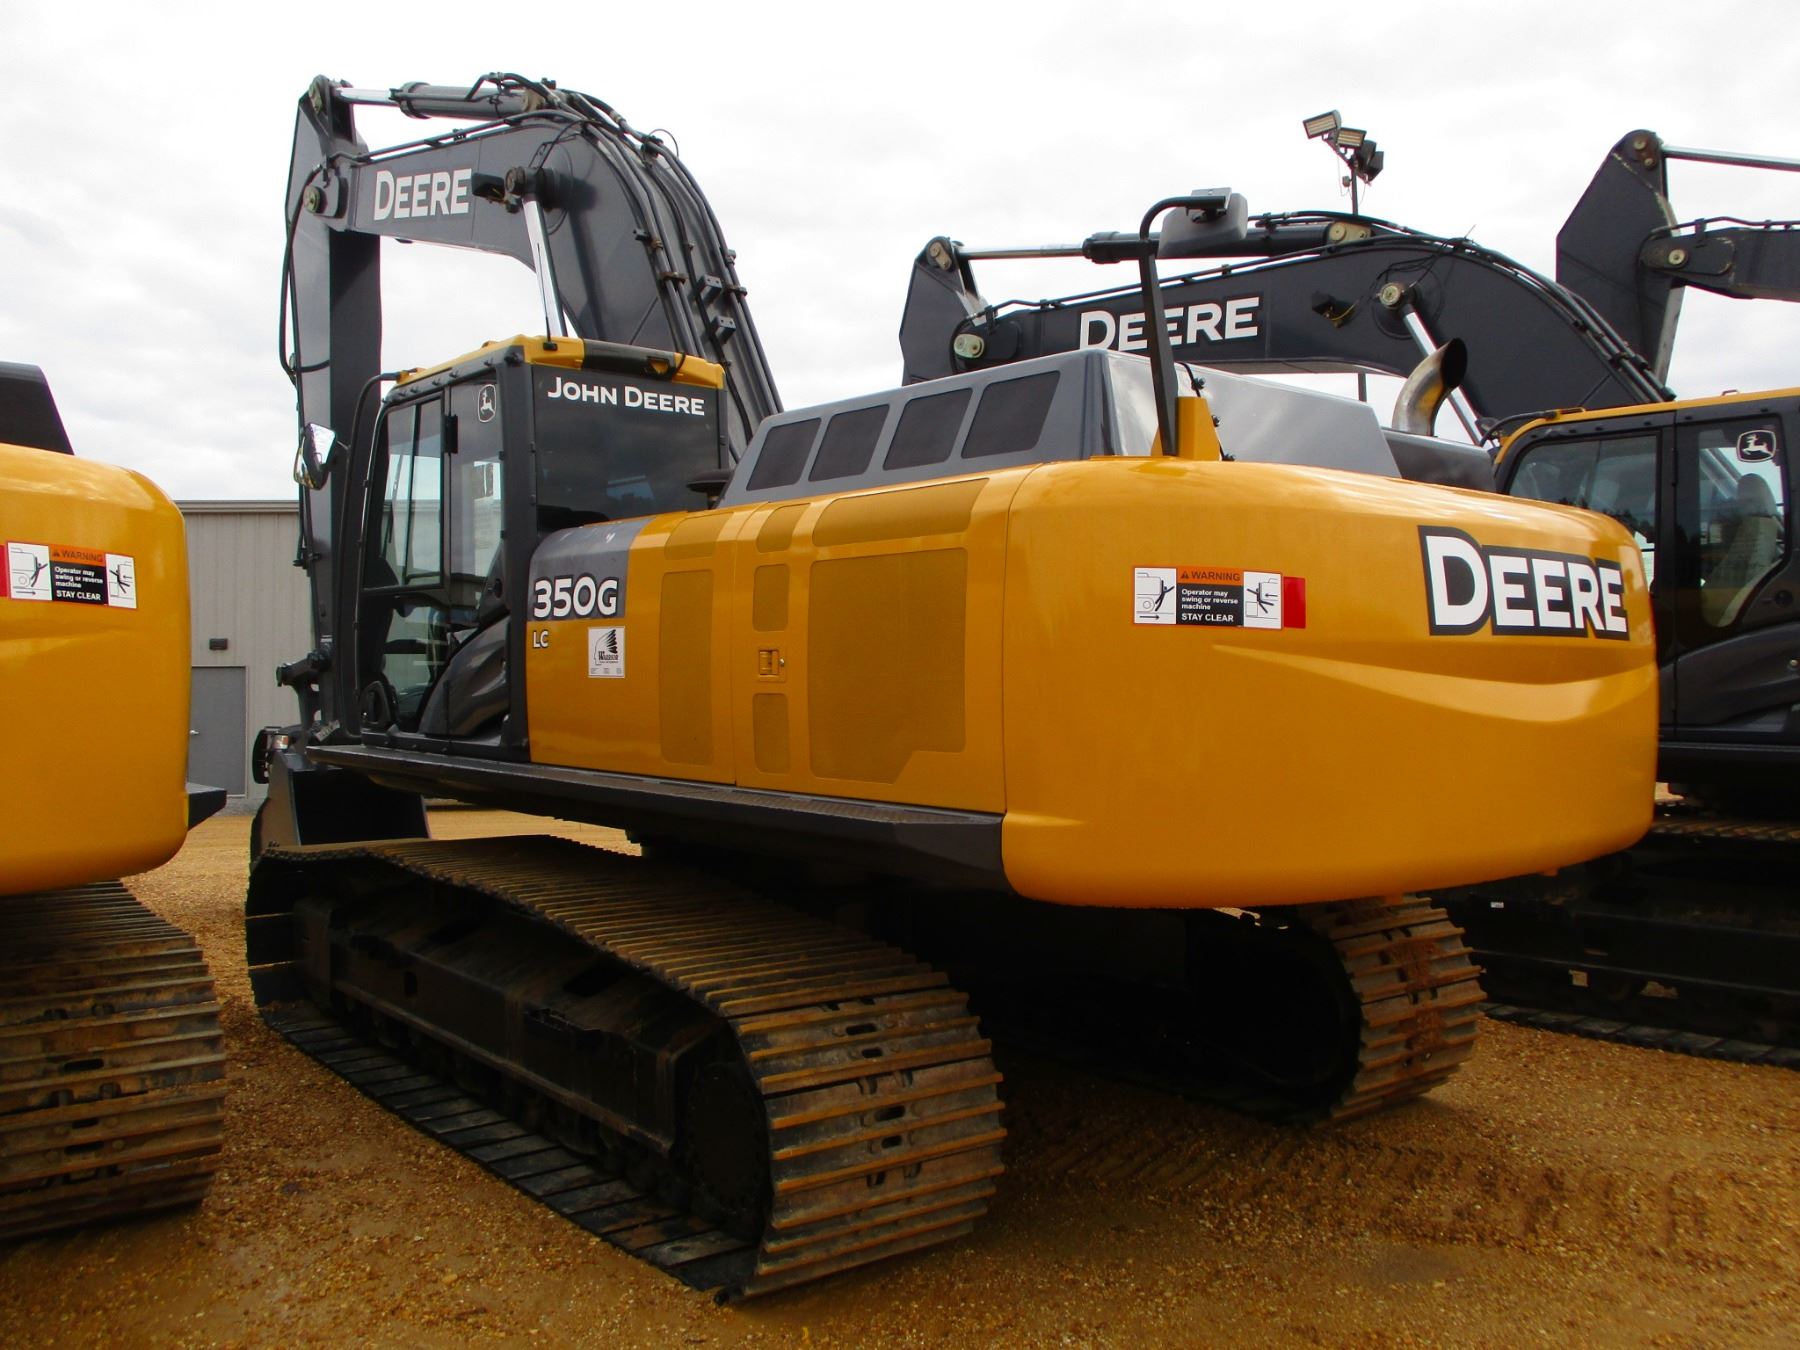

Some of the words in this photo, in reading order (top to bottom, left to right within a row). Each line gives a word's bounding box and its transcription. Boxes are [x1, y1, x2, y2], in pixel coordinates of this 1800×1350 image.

[374, 168, 472, 220] DEERE
[547, 376, 618, 406] JOHN
[624, 385, 705, 416] DEERE
[62, 550, 103, 563] WARNING
[1191, 571, 1240, 582] WARNING
[1425, 535, 1628, 633] DEERE
[56, 590, 75, 598] STAY
[76, 591, 101, 601] CLEAR
[533, 576, 618, 618] 350G
[1181, 588, 1212, 596] Operator
[1213, 590, 1229, 598] may
[1181, 596, 1203, 604] swing
[1181, 613, 1203, 621] STAY
[1204, 613, 1234, 622] CLEAR
[533, 631, 549, 648] LC
